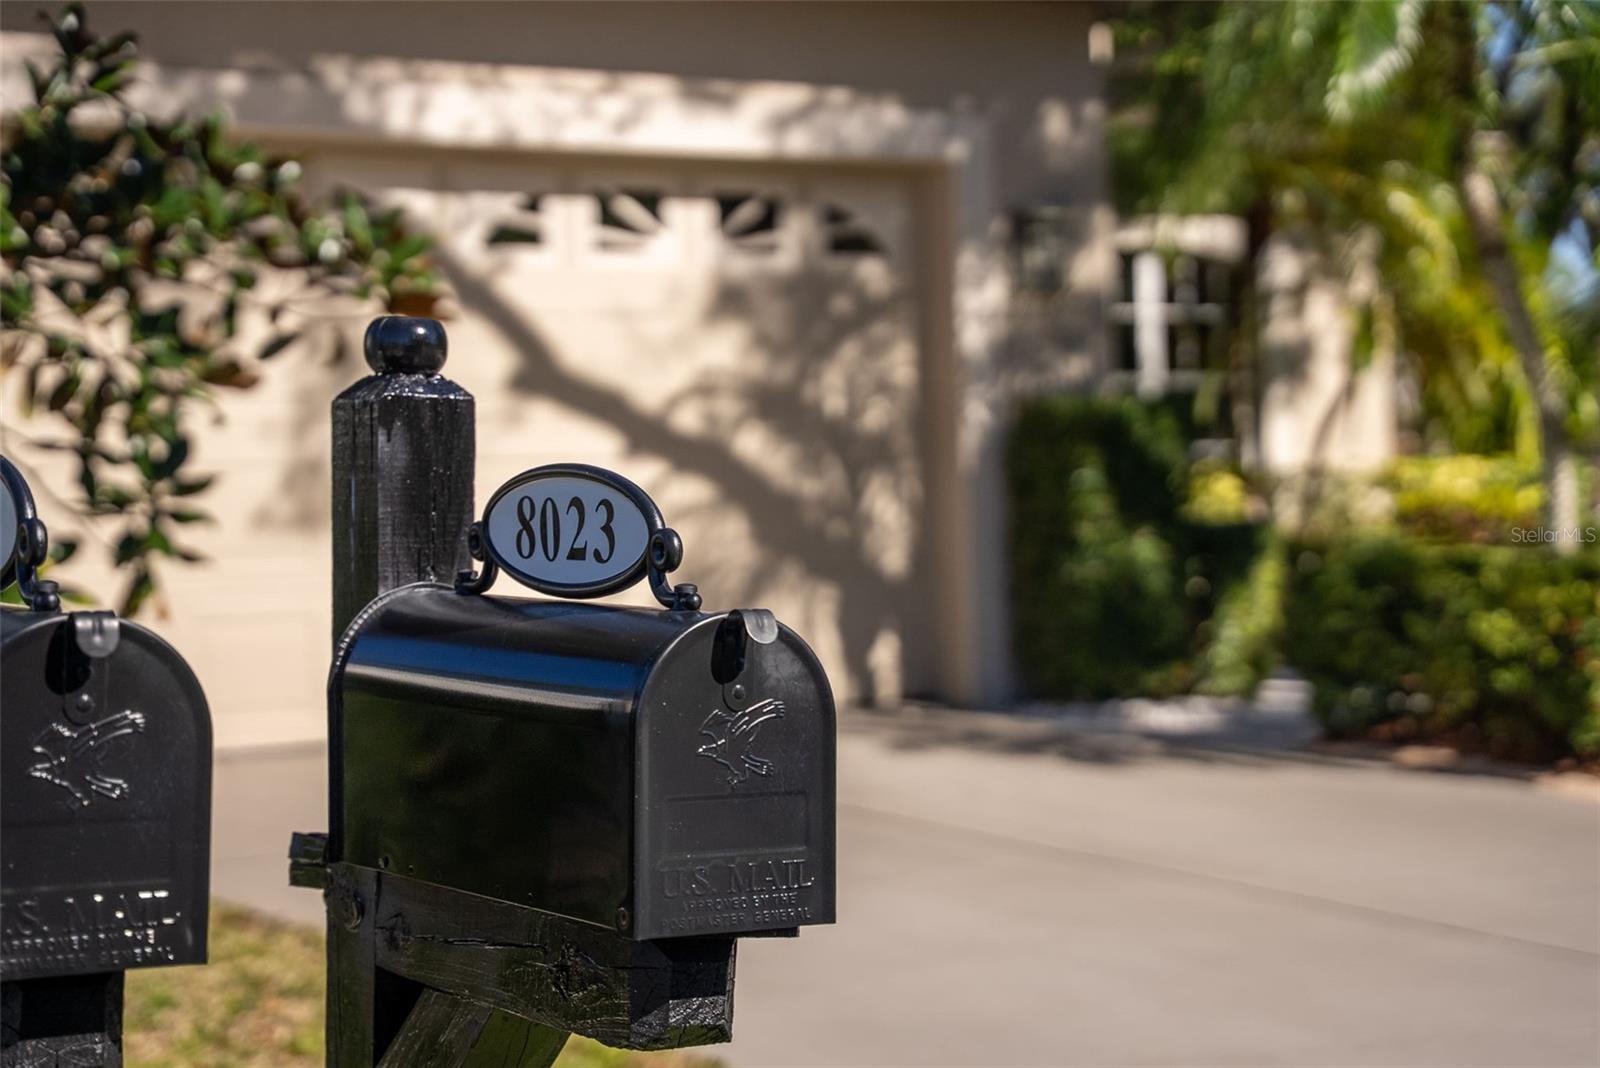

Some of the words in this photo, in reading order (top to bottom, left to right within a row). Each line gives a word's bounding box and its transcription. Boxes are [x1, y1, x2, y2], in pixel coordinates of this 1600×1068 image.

[516, 495, 616, 564] 8023
[657, 866, 717, 898] U.S.
[727, 858, 815, 893] MAIL
